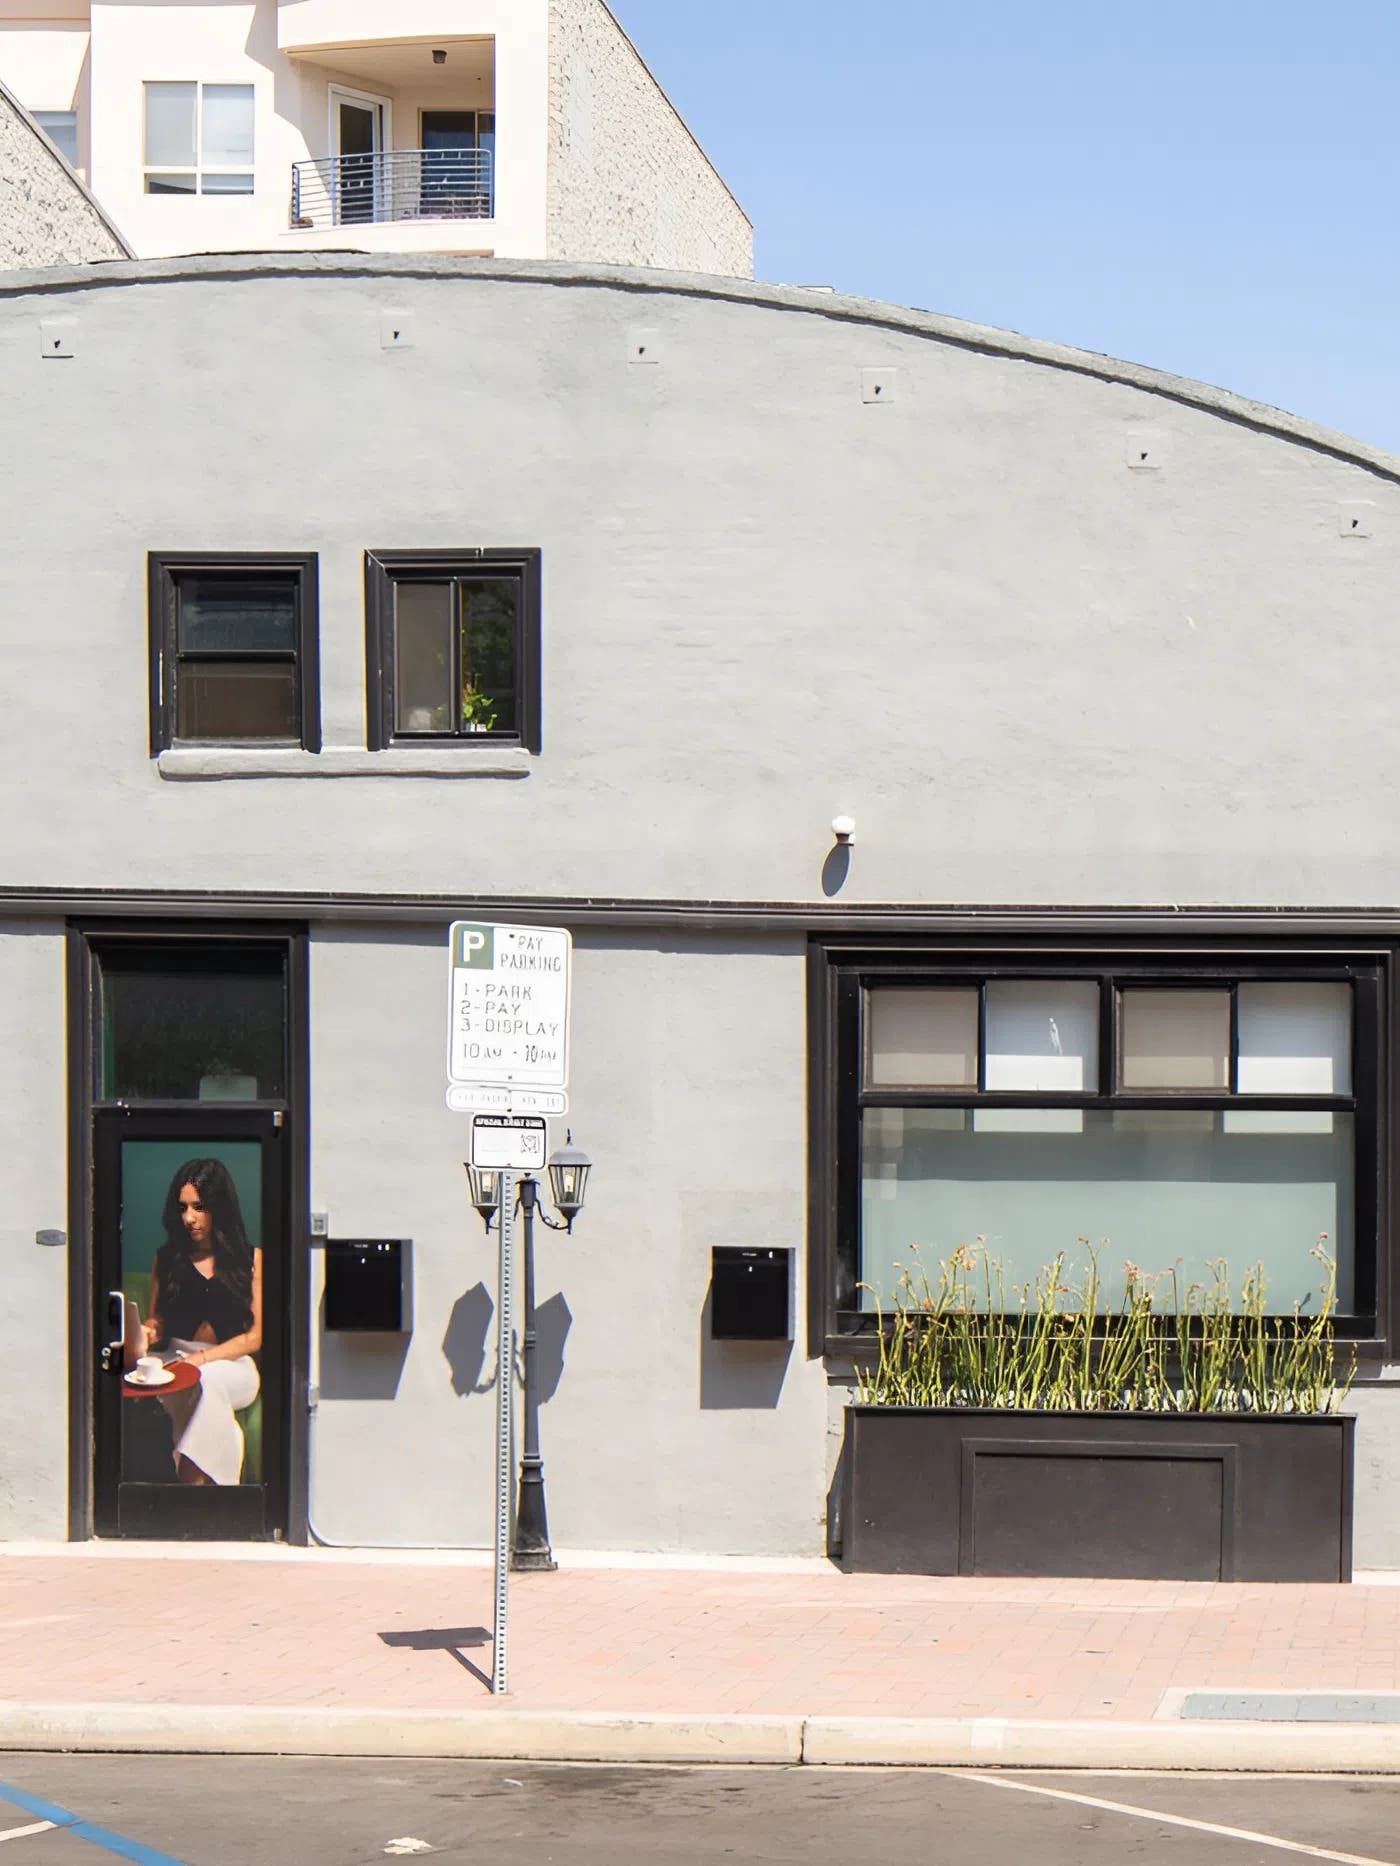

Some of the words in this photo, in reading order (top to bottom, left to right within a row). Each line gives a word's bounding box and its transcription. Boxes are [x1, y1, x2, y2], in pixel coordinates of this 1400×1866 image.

[463, 930, 485, 962] P
[518, 935, 543, 951] PAY
[500, 952, 561, 973] PARKING
